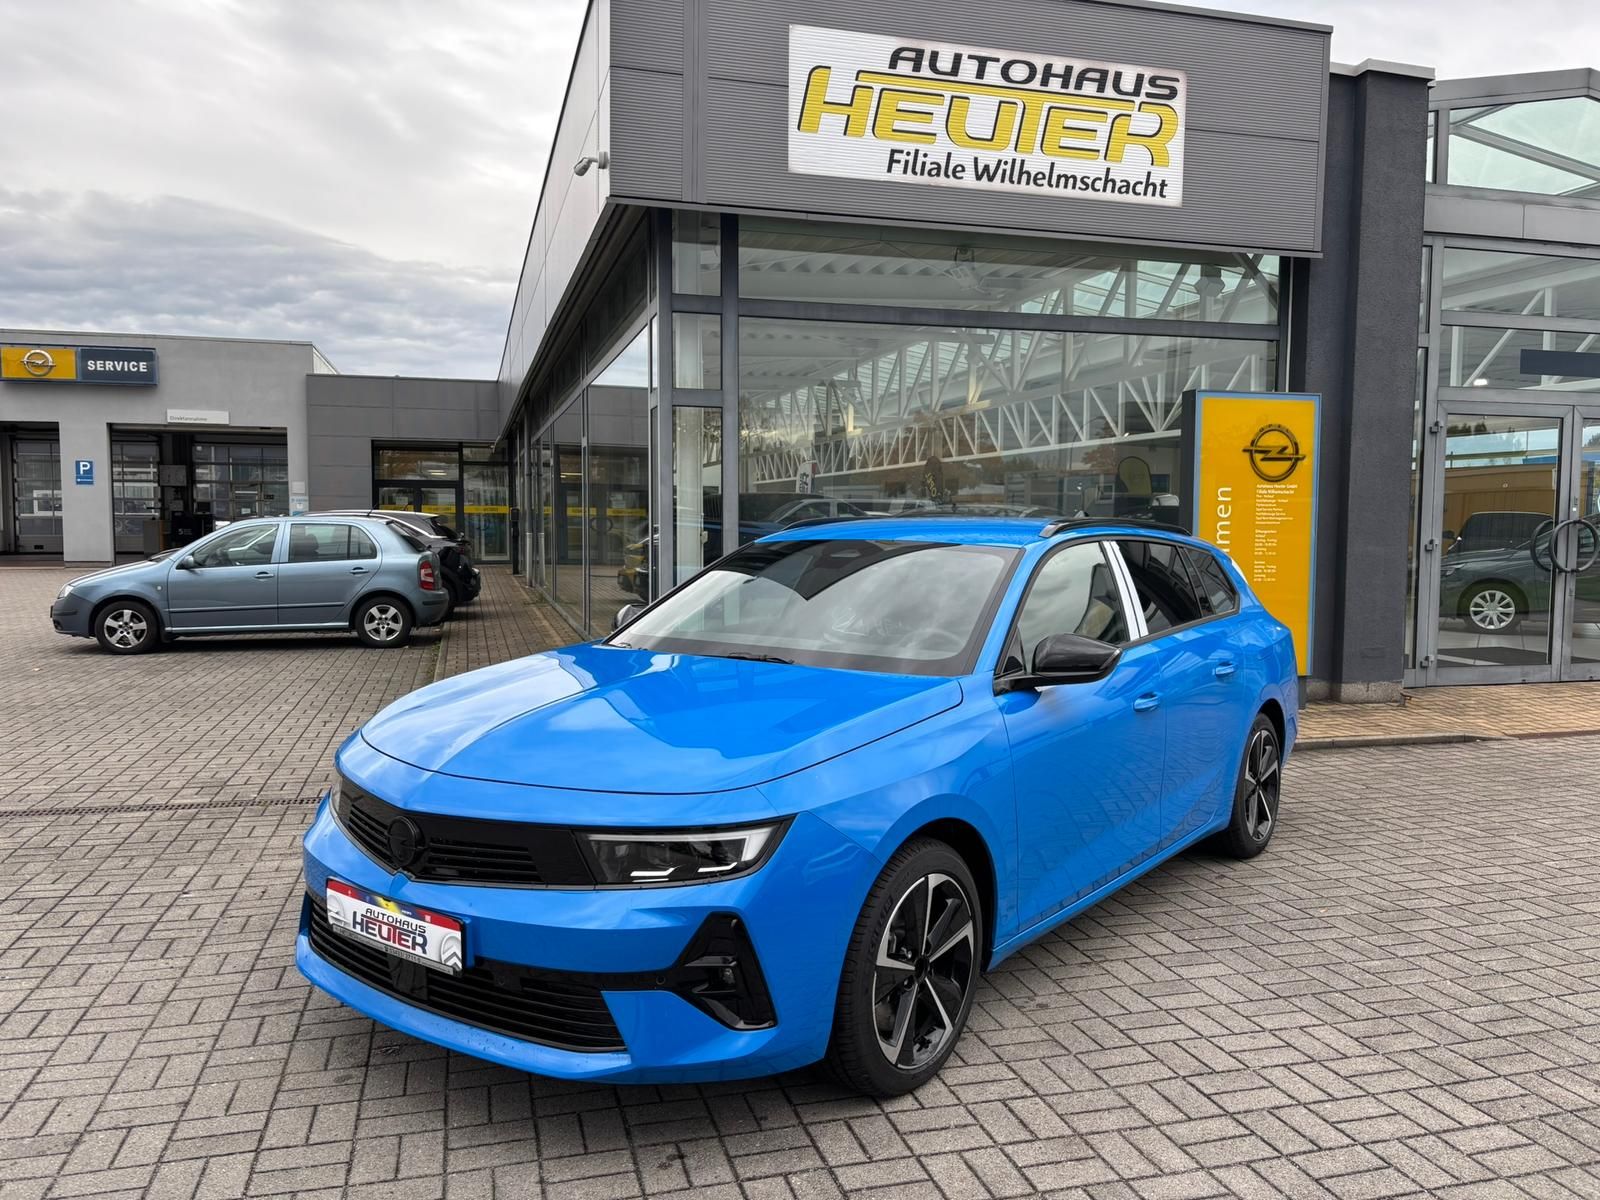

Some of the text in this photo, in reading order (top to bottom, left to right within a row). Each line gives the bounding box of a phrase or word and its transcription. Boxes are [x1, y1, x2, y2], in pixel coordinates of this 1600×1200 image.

[888, 46, 1180, 100] AUTOHAUS
[797, 65, 1179, 168] HEUTER
[886, 148, 1168, 199] Filiale Wilhelmschacht
[87, 360, 148, 373] SERVICE
[79, 461, 91, 475] P
[1216, 486, 1232, 553] men
[352, 911, 428, 954] HEUTER
[365, 907, 427, 934] AUTOHAUS
